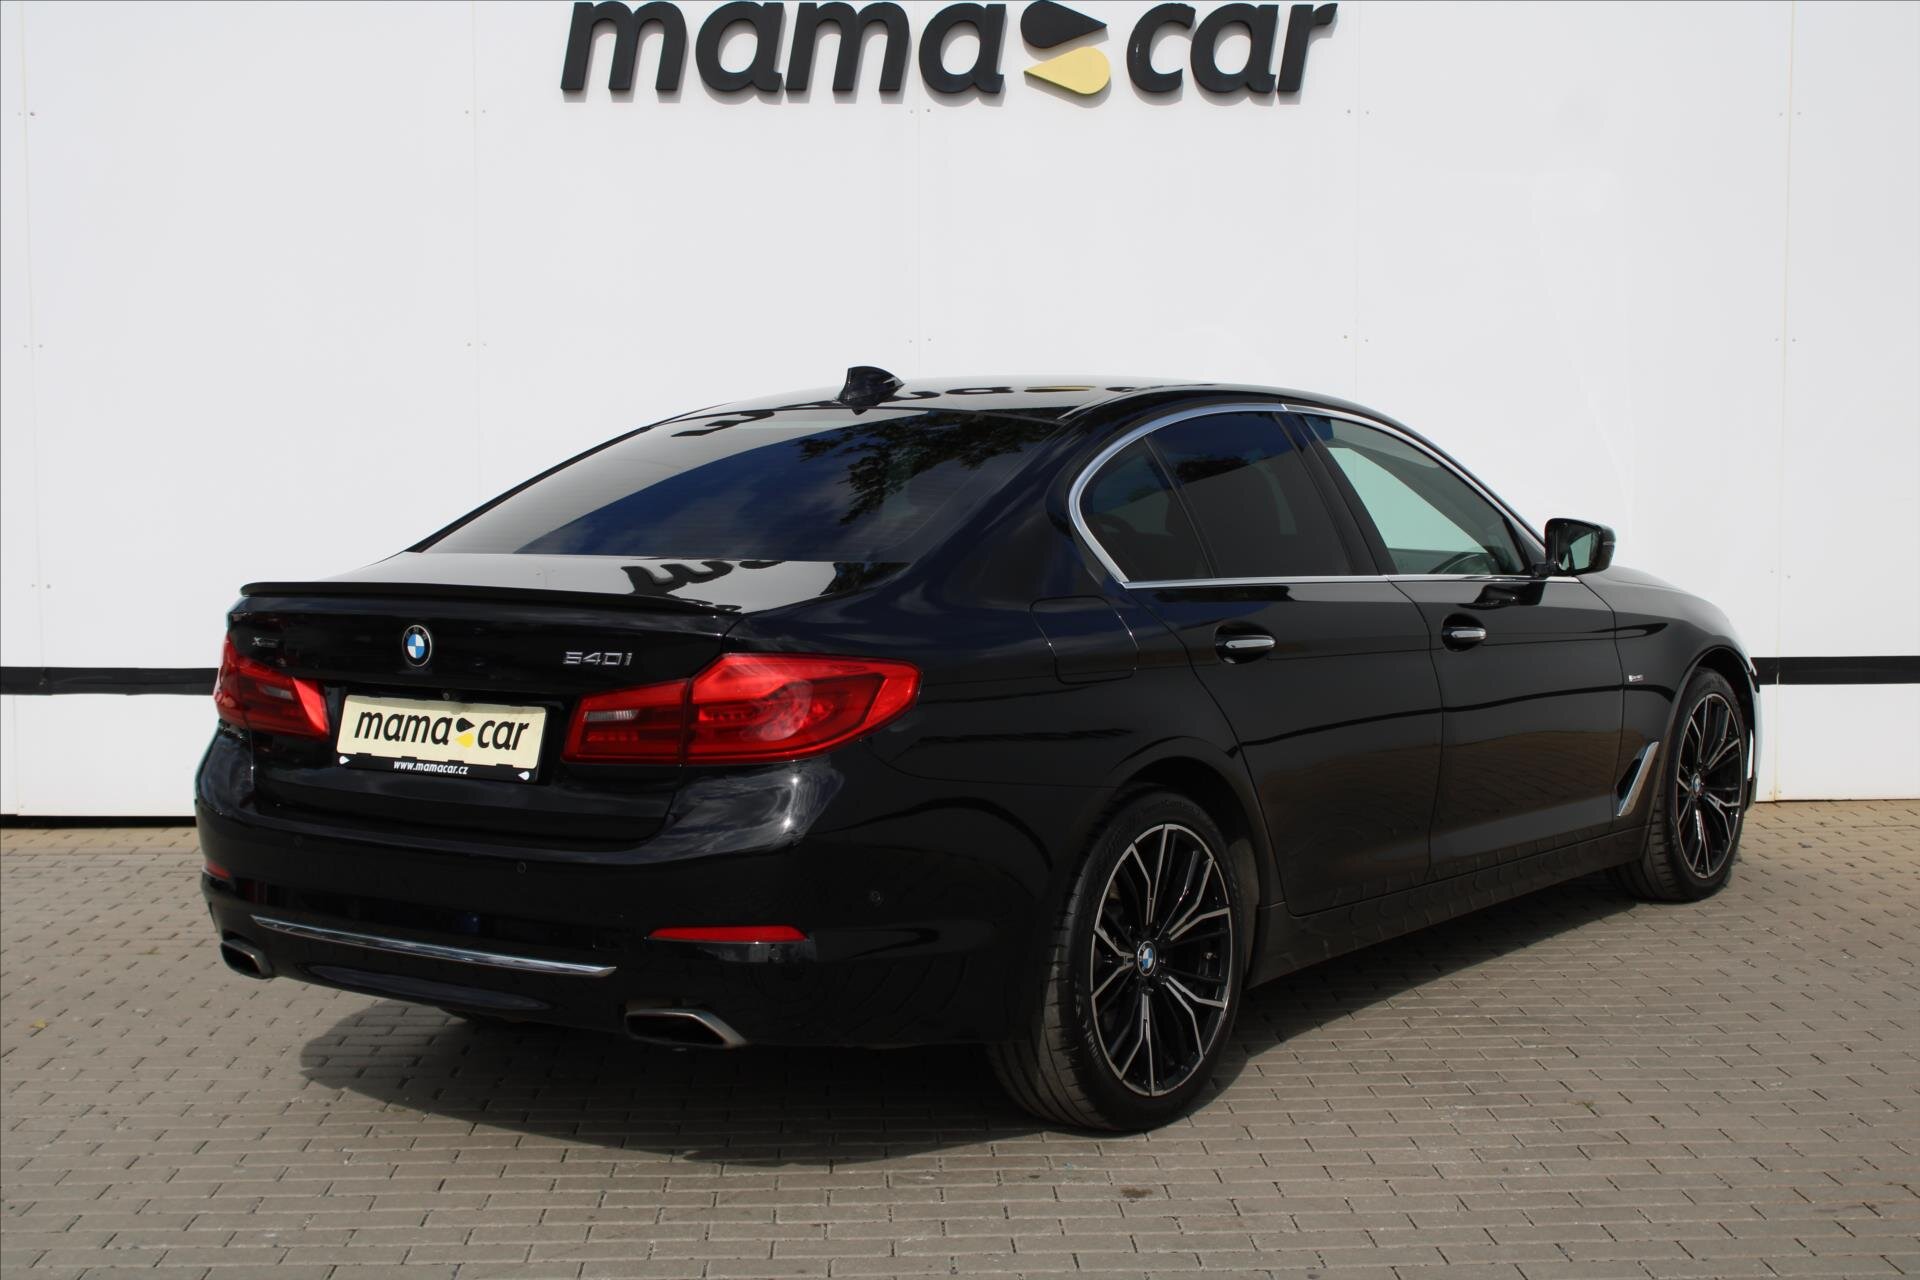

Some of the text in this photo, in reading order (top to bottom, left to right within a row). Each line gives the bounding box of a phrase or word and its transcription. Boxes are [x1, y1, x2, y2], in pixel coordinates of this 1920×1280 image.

[560, 0, 1338, 94] mama car
[354, 711, 530, 751] mama car
[393, 760, 469, 775] www.mamacar.cz
